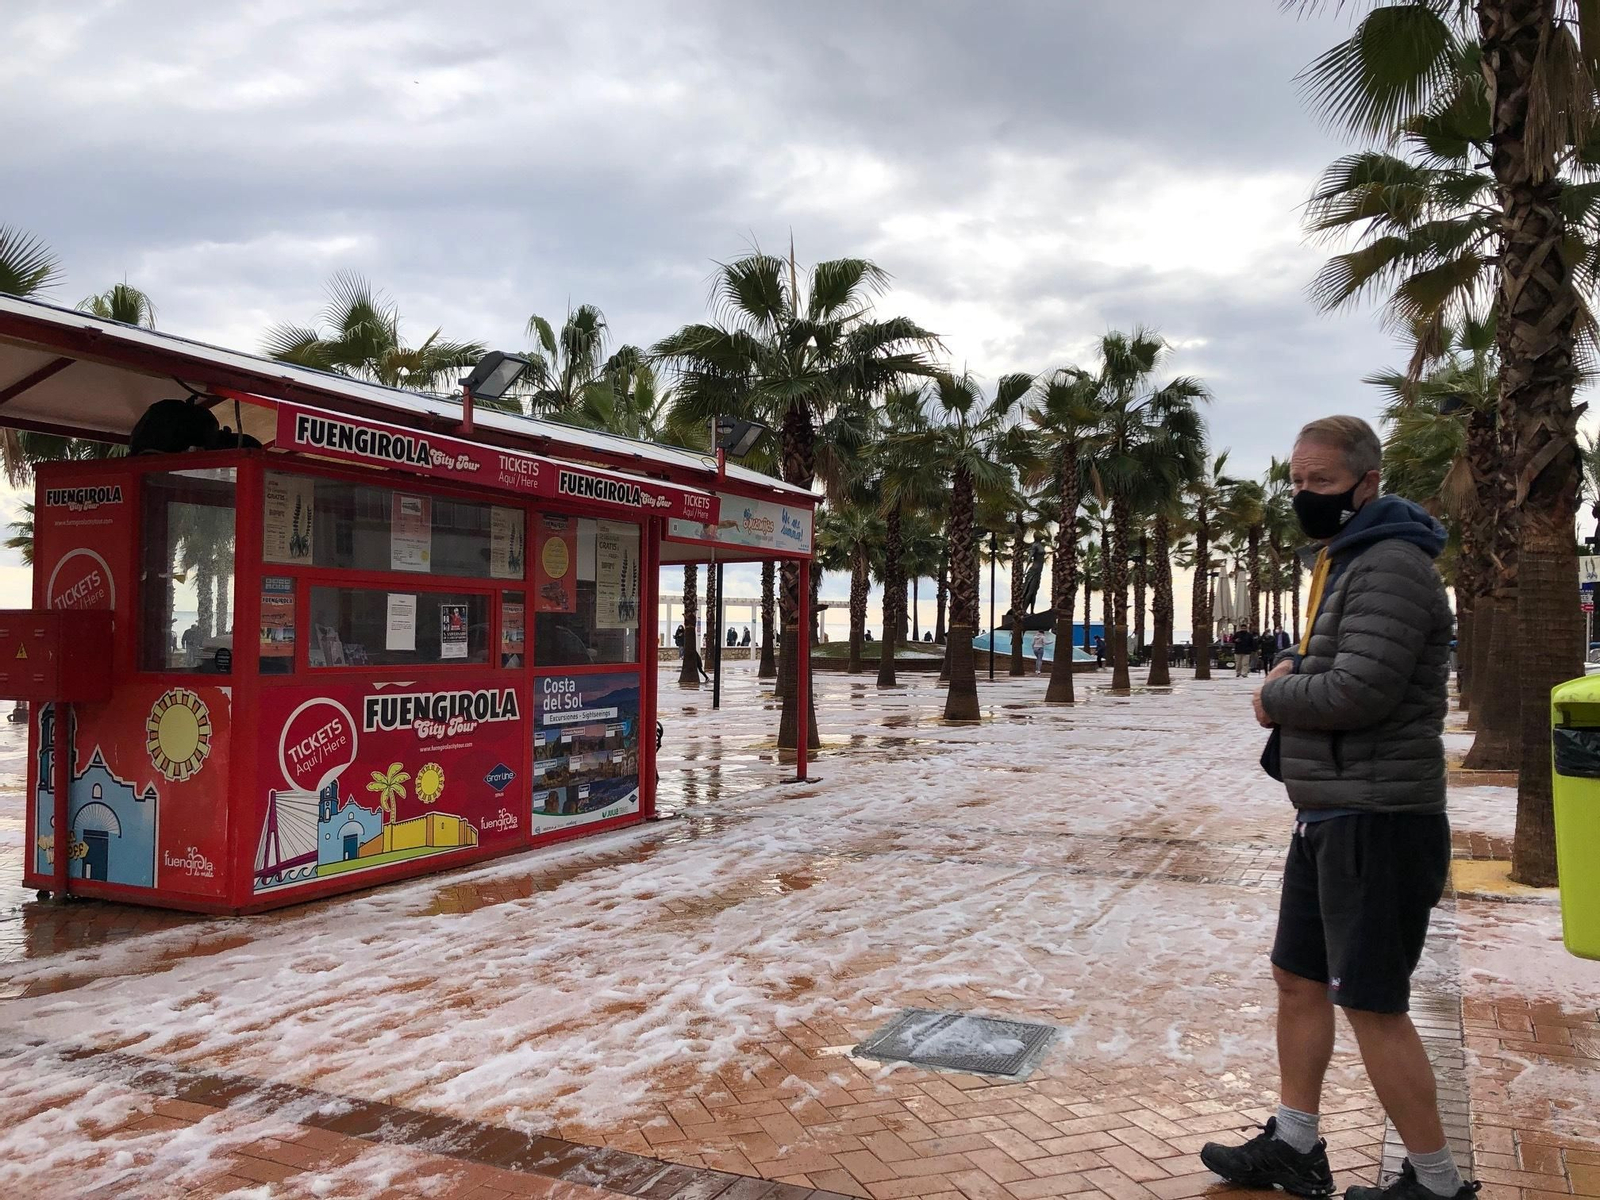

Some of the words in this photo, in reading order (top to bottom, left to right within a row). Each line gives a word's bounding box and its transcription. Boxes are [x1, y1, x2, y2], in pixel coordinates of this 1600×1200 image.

[295, 413, 432, 469] FUENGIROLA
[430, 449, 454, 469] City
[456, 455, 480, 471] Tour
[499, 455, 539, 476] TICKETS
[46, 486, 123, 507] FUENGIROLA
[558, 470, 642, 507] FUENGIROLA
[641, 492, 656, 507] City
[656, 496, 672, 507] Tour
[684, 494, 710, 509] TICKETS
[54, 570, 100, 610] TICKETS
[543, 677, 575, 694] Costa
[363, 688, 520, 732] FUENGIROLA
[543, 694, 561, 711] del
[565, 692, 583, 709] Sol
[413, 719, 445, 739] City
[447, 716, 477, 736] Tour
[550, 712, 578, 722] Excursiones
[582, 710, 611, 720] Sightseeings
[288, 718, 342, 763] TICKETS
[481, 808, 518, 832] fuengirola
[164, 847, 213, 876] fuengirola
